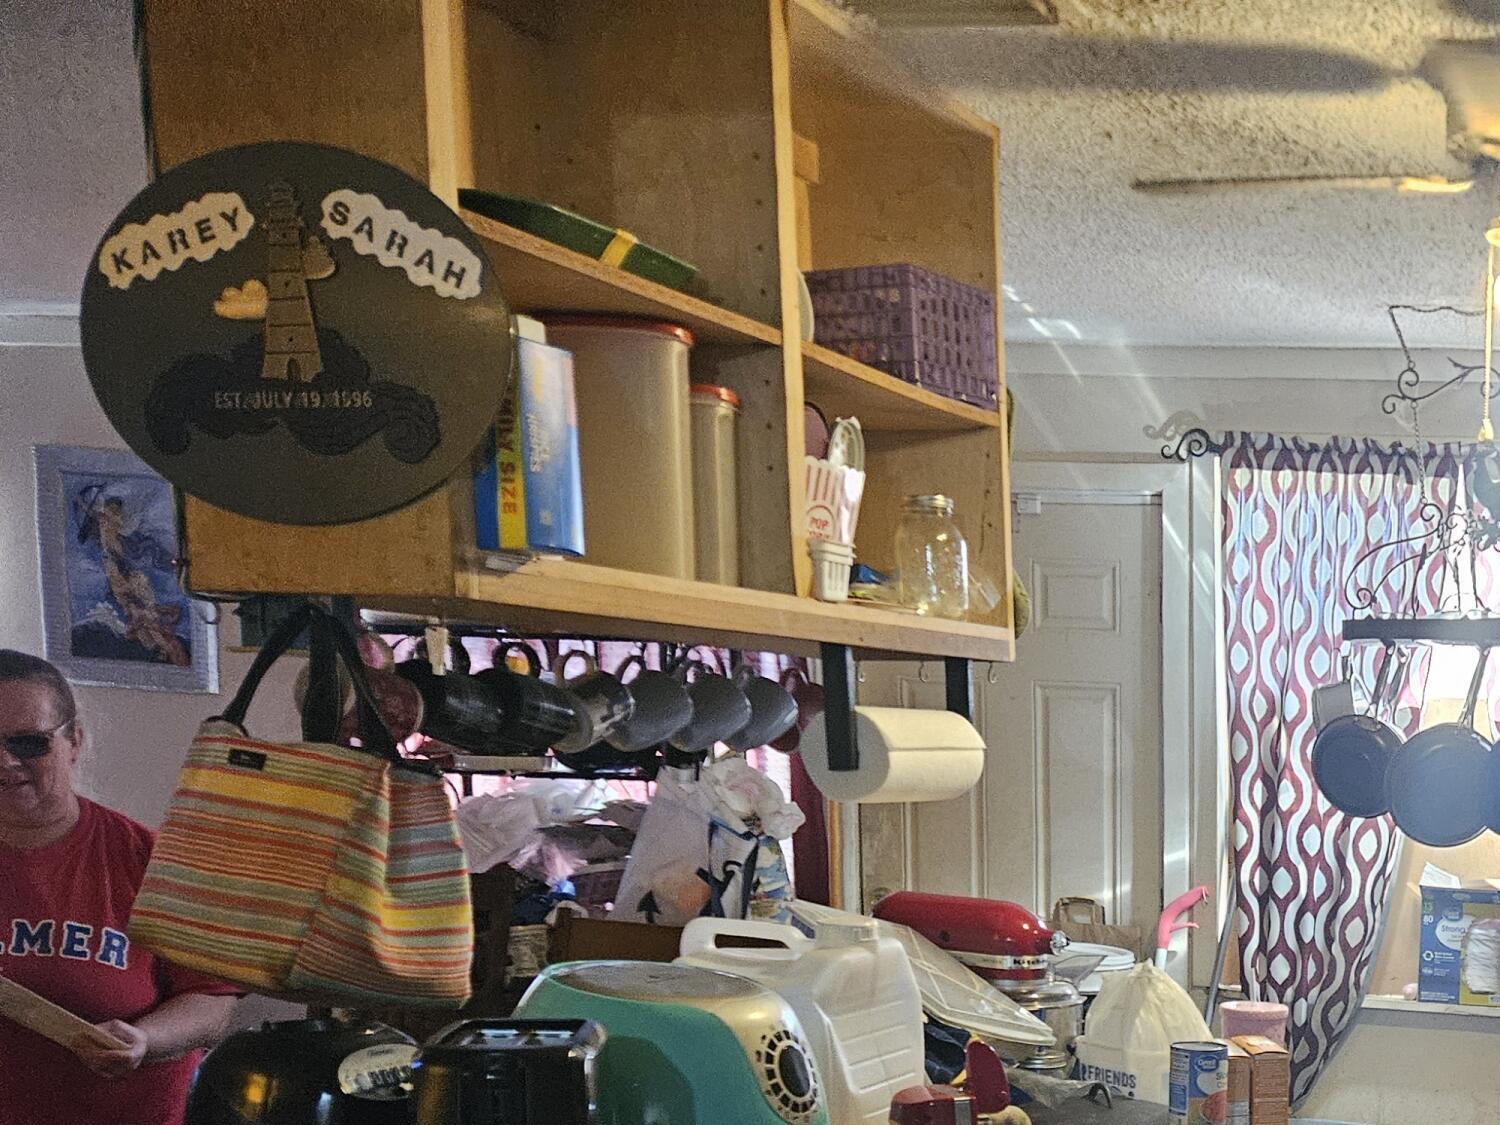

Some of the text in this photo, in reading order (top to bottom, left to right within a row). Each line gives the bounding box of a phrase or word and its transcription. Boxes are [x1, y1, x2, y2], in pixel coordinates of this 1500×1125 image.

[110, 207, 240, 275] KAREY
[328, 201, 468, 290] SARAH
[252, 390, 293, 410] JULY
[501, 461, 518, 514] SIZE
[0, 919, 130, 971] MER
[1088, 1064, 1137, 1089] FRIENDS
